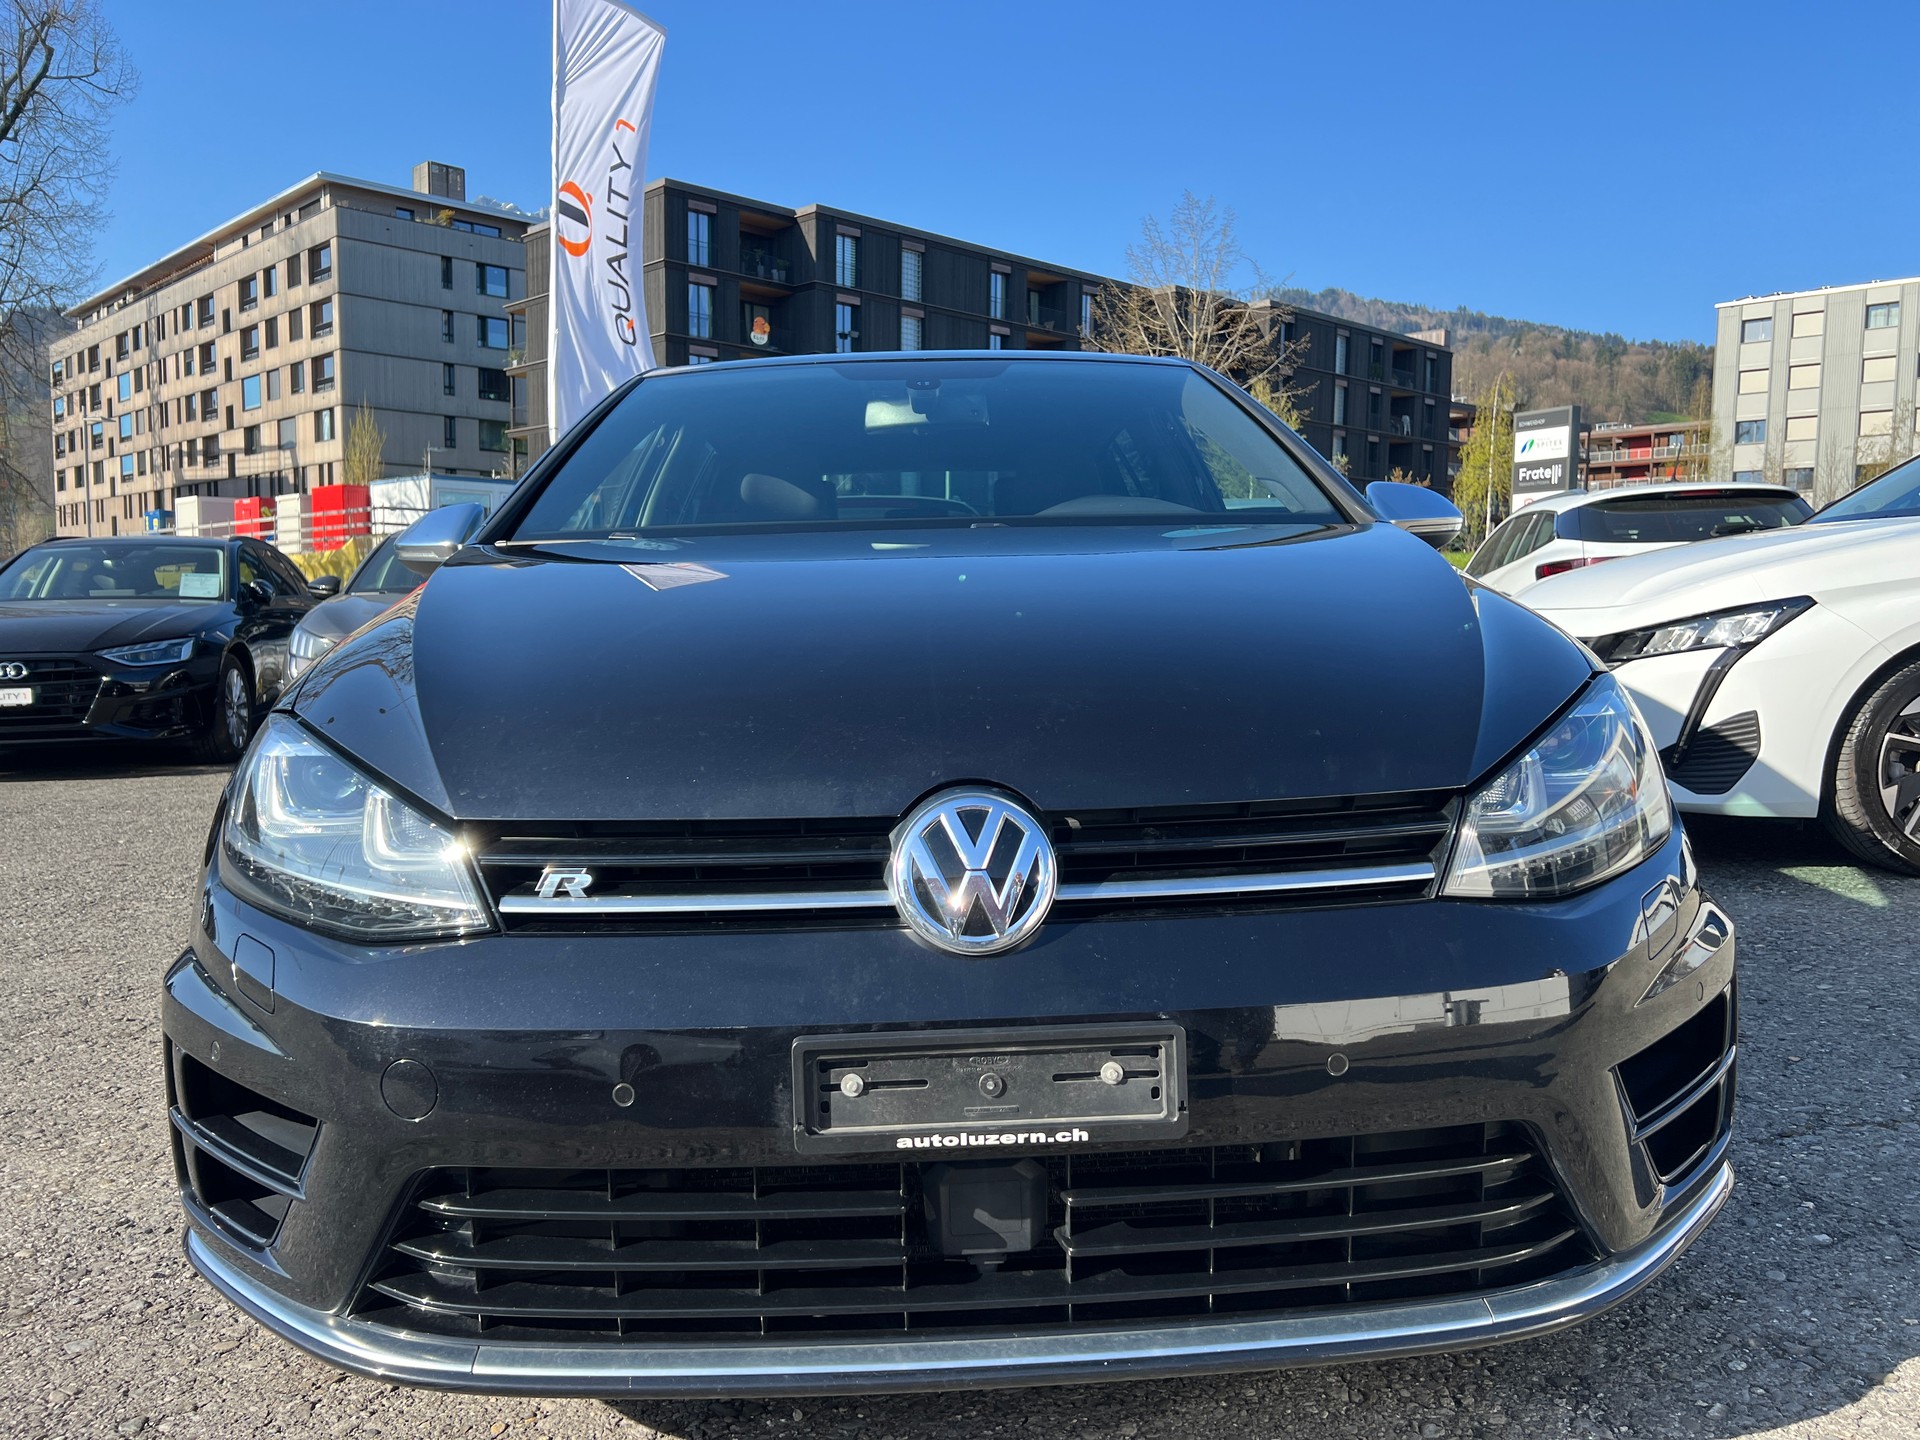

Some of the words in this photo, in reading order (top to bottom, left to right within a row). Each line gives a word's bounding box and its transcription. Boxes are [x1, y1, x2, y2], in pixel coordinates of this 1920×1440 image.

[606, 141, 637, 346] QUALITY
[1518, 464, 1562, 485] Fratelli
[0, 692, 20, 700] ITY
[535, 866, 593, 898] R
[896, 1128, 1089, 1149] autoluzern.ch
